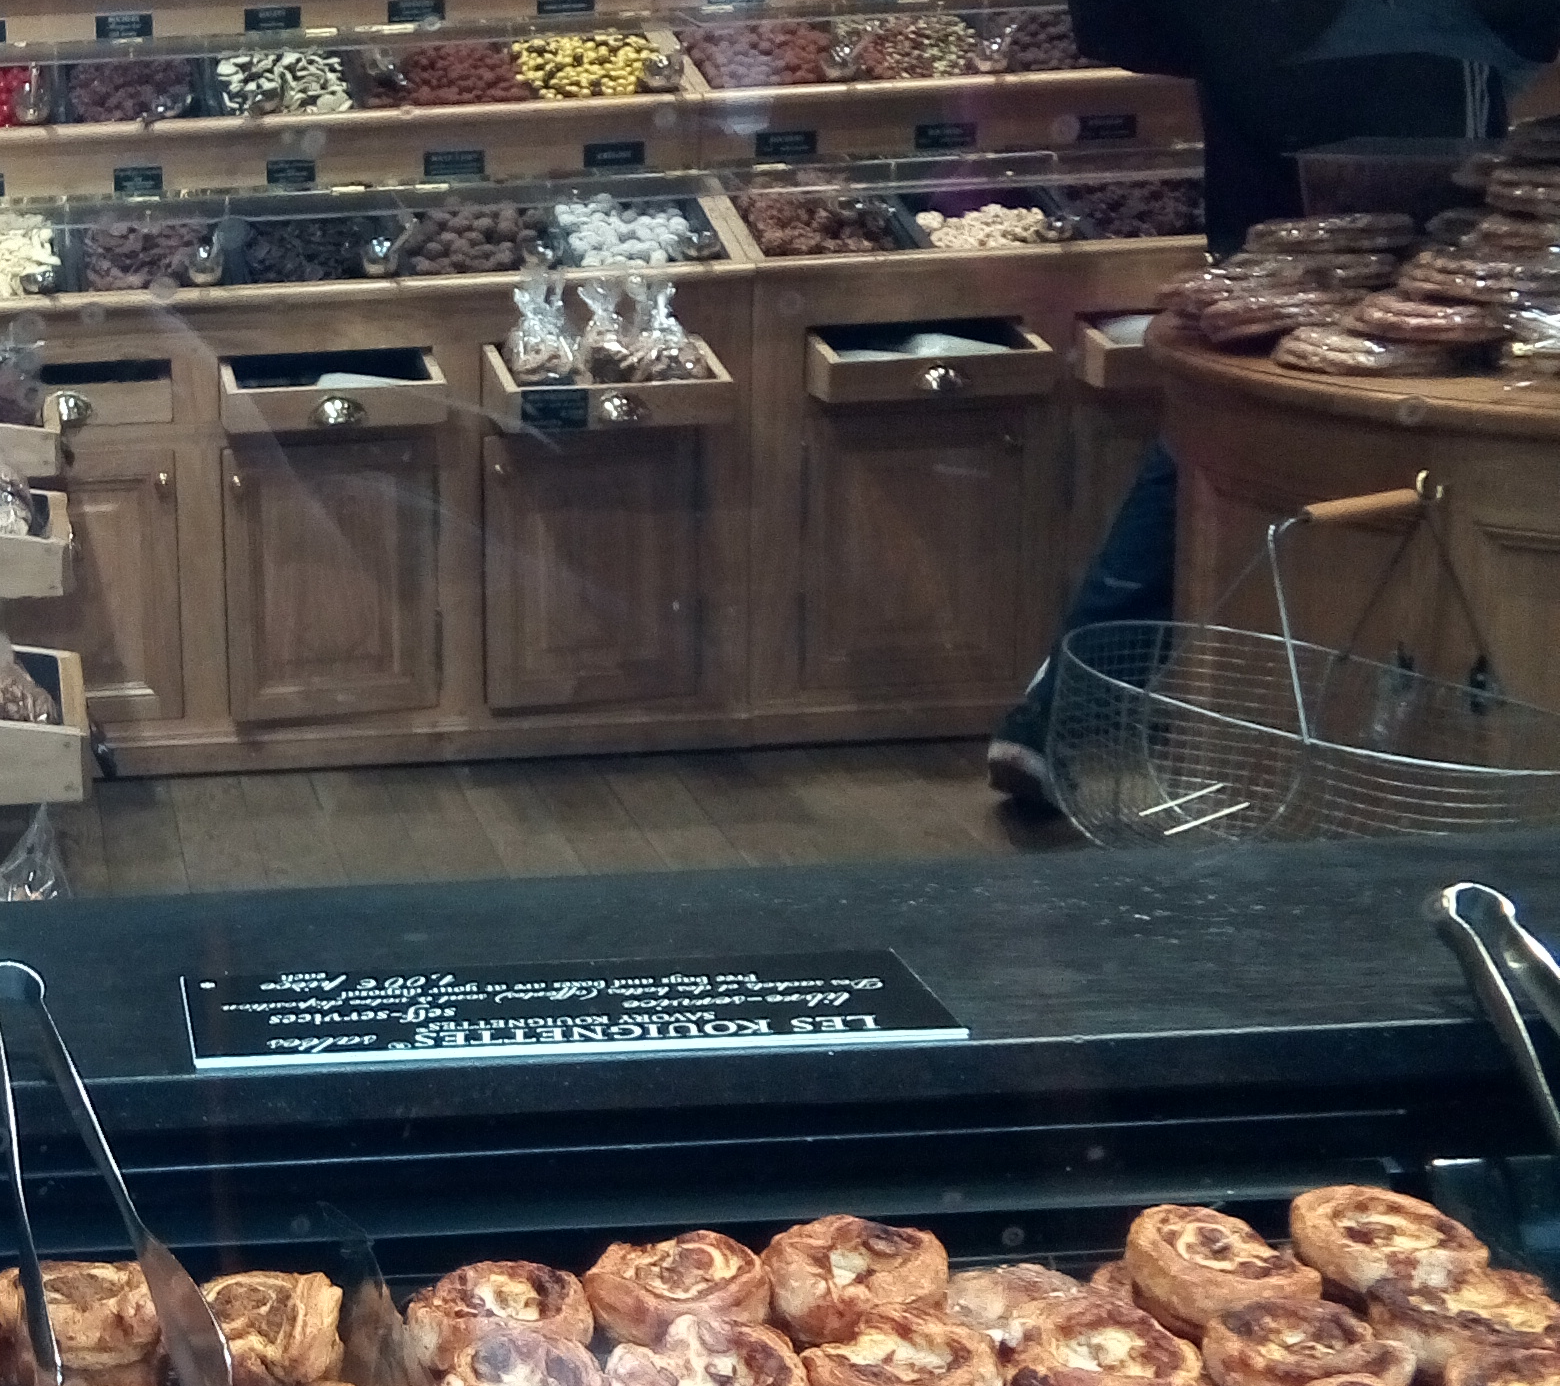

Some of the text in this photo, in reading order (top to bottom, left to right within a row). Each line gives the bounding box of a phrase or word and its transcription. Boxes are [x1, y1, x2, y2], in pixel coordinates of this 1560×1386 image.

[621, 991, 850, 1011] libre-service
[618, 1010, 716, 1024] SAVORY
[789, 1014, 882, 1033] LES
